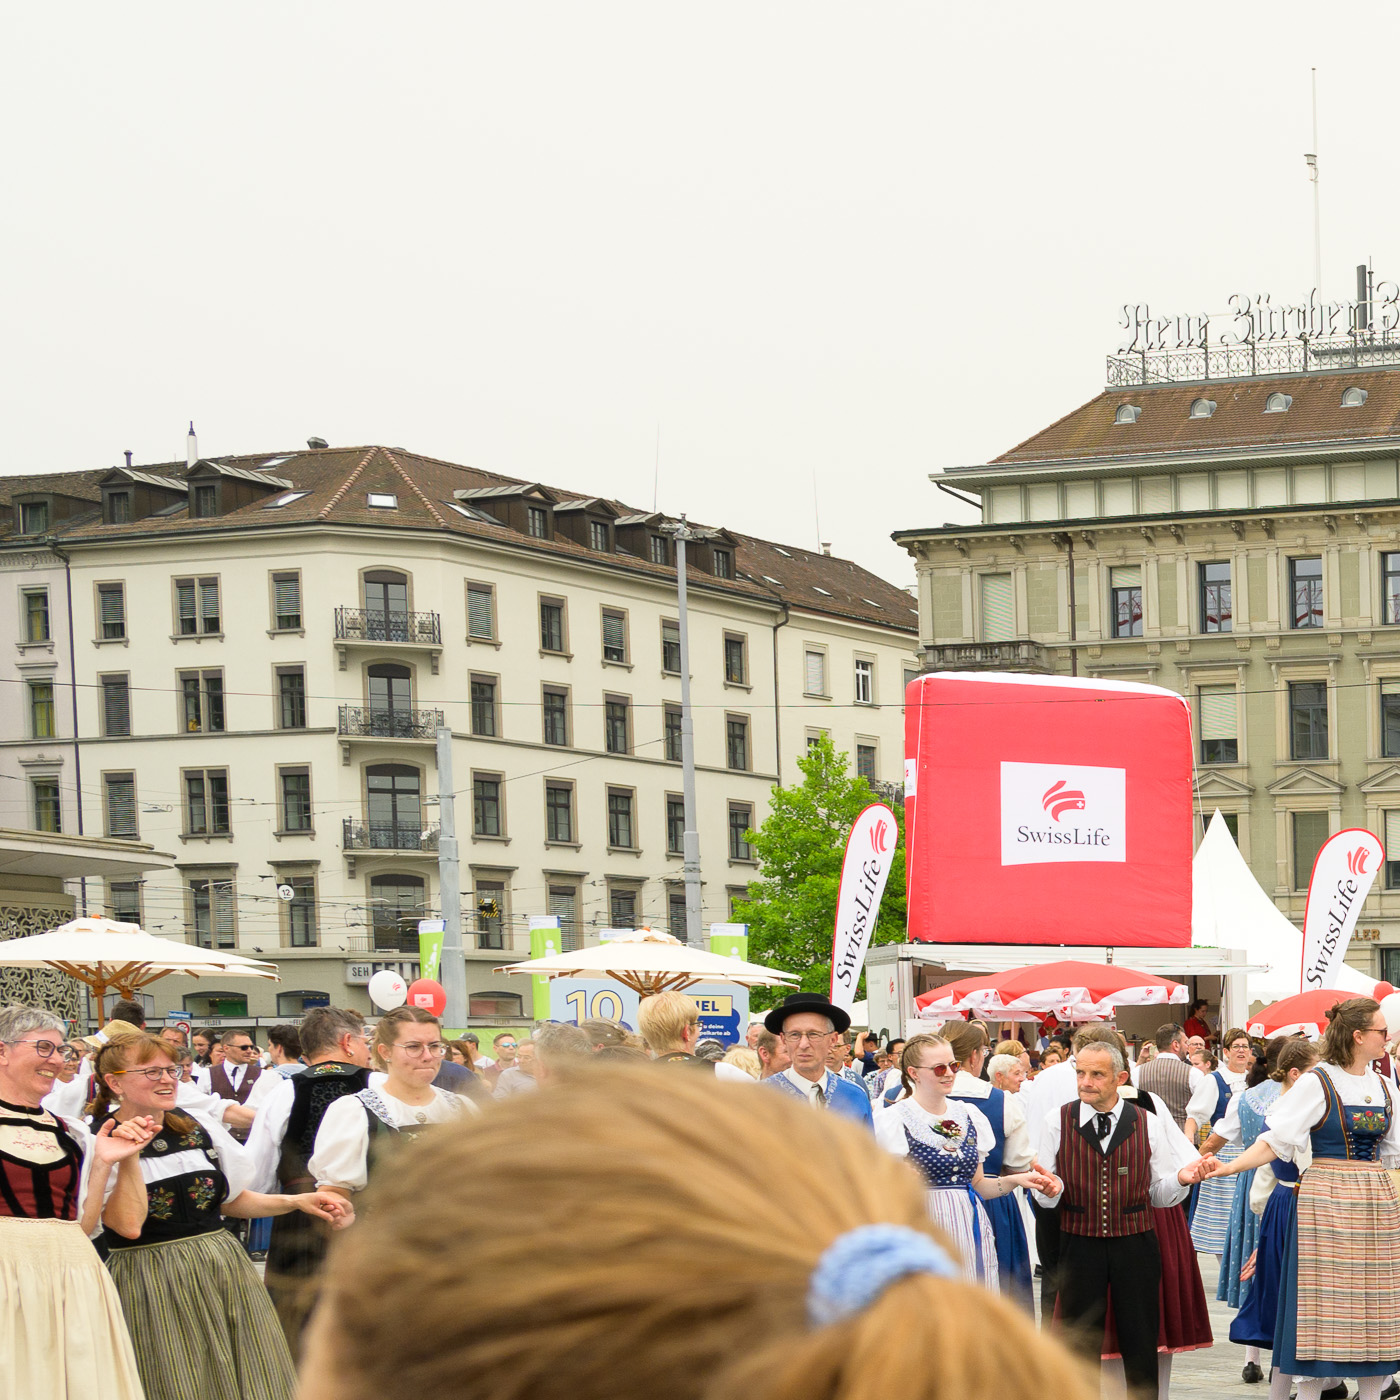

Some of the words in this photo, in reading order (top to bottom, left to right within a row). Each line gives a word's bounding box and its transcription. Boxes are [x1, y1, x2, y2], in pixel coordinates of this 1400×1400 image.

[1117, 302, 1209, 354] Neue
[1221, 287, 1359, 345] Zürcher
[1017, 825, 1111, 847] SwissLife
[282, 888, 291, 897] 12
[836, 858, 881, 989] SwissLife
[1306, 879, 1358, 988] SwissLife
[352, 967, 369, 977] SEH
[566, 989, 624, 1027] 10
